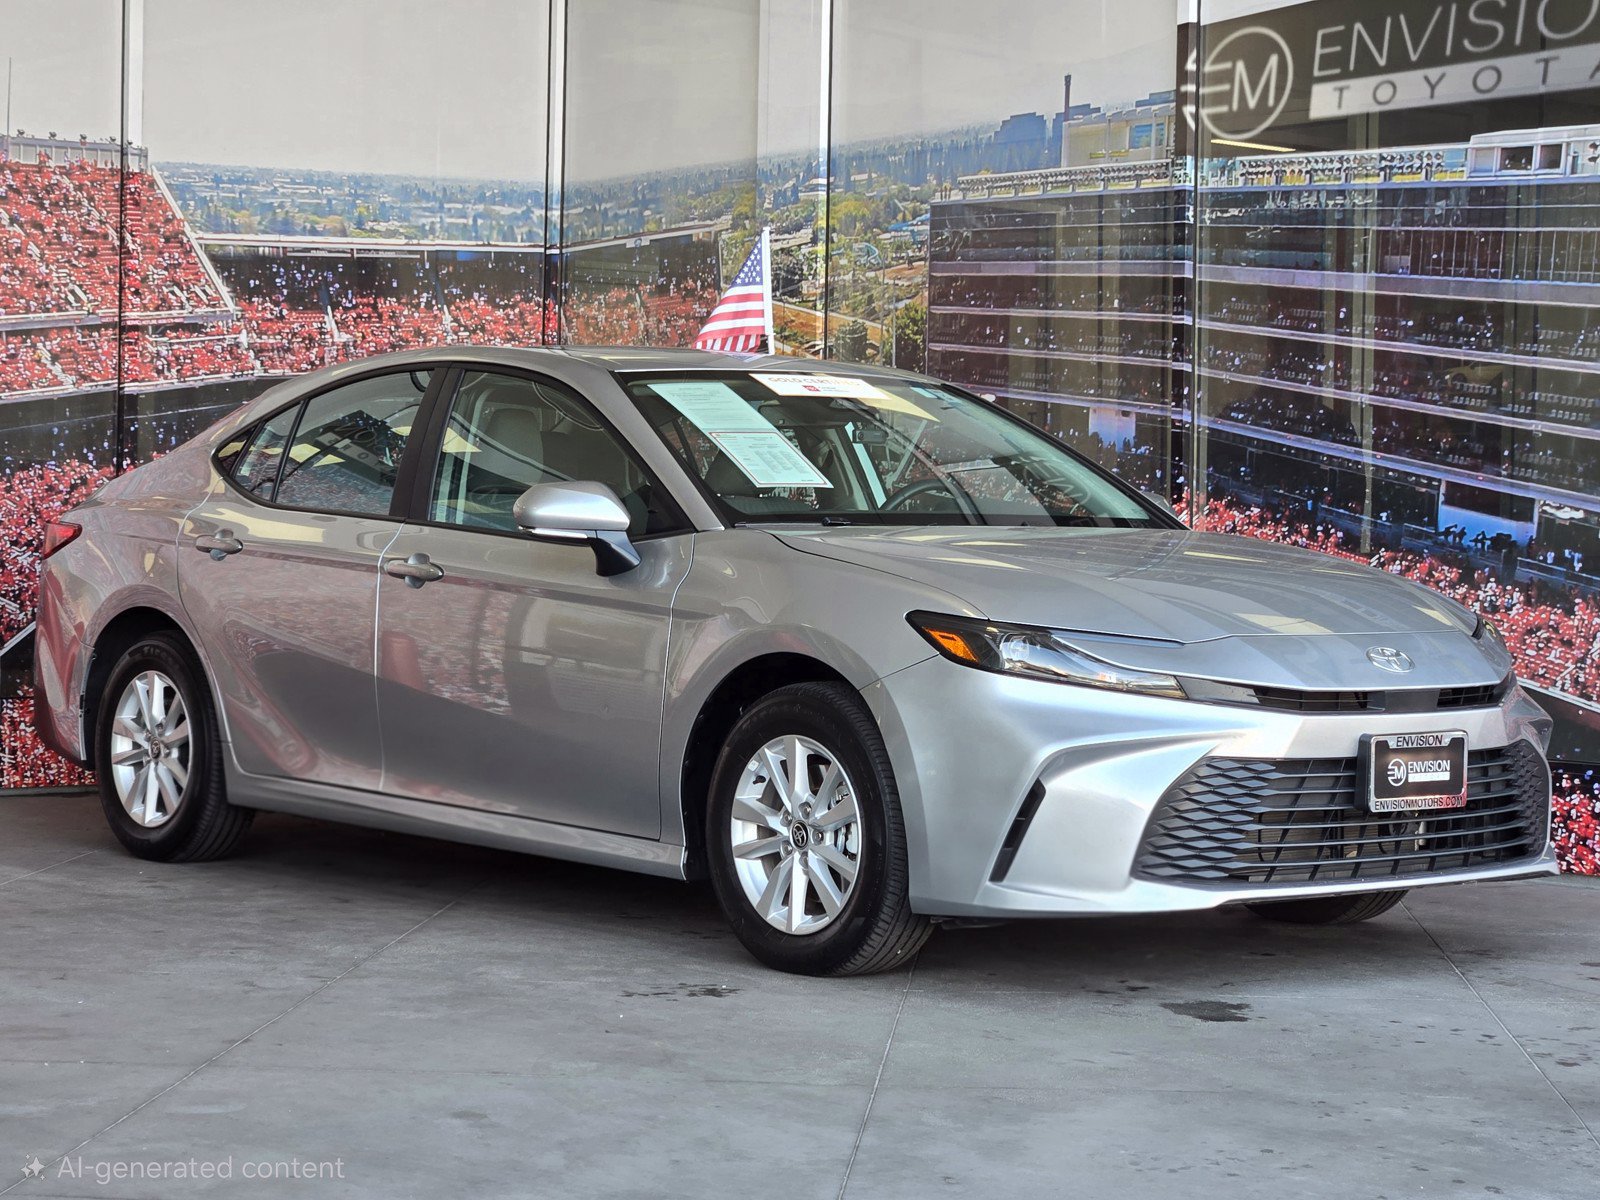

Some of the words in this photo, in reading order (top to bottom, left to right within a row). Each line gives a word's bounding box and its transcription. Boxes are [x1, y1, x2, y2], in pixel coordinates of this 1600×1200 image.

[1396, 735, 1443, 747] ENVISION
[1408, 760, 1450, 773] ENVISION
[1375, 796, 1462, 810] ENVISIONMOTORS.COM
